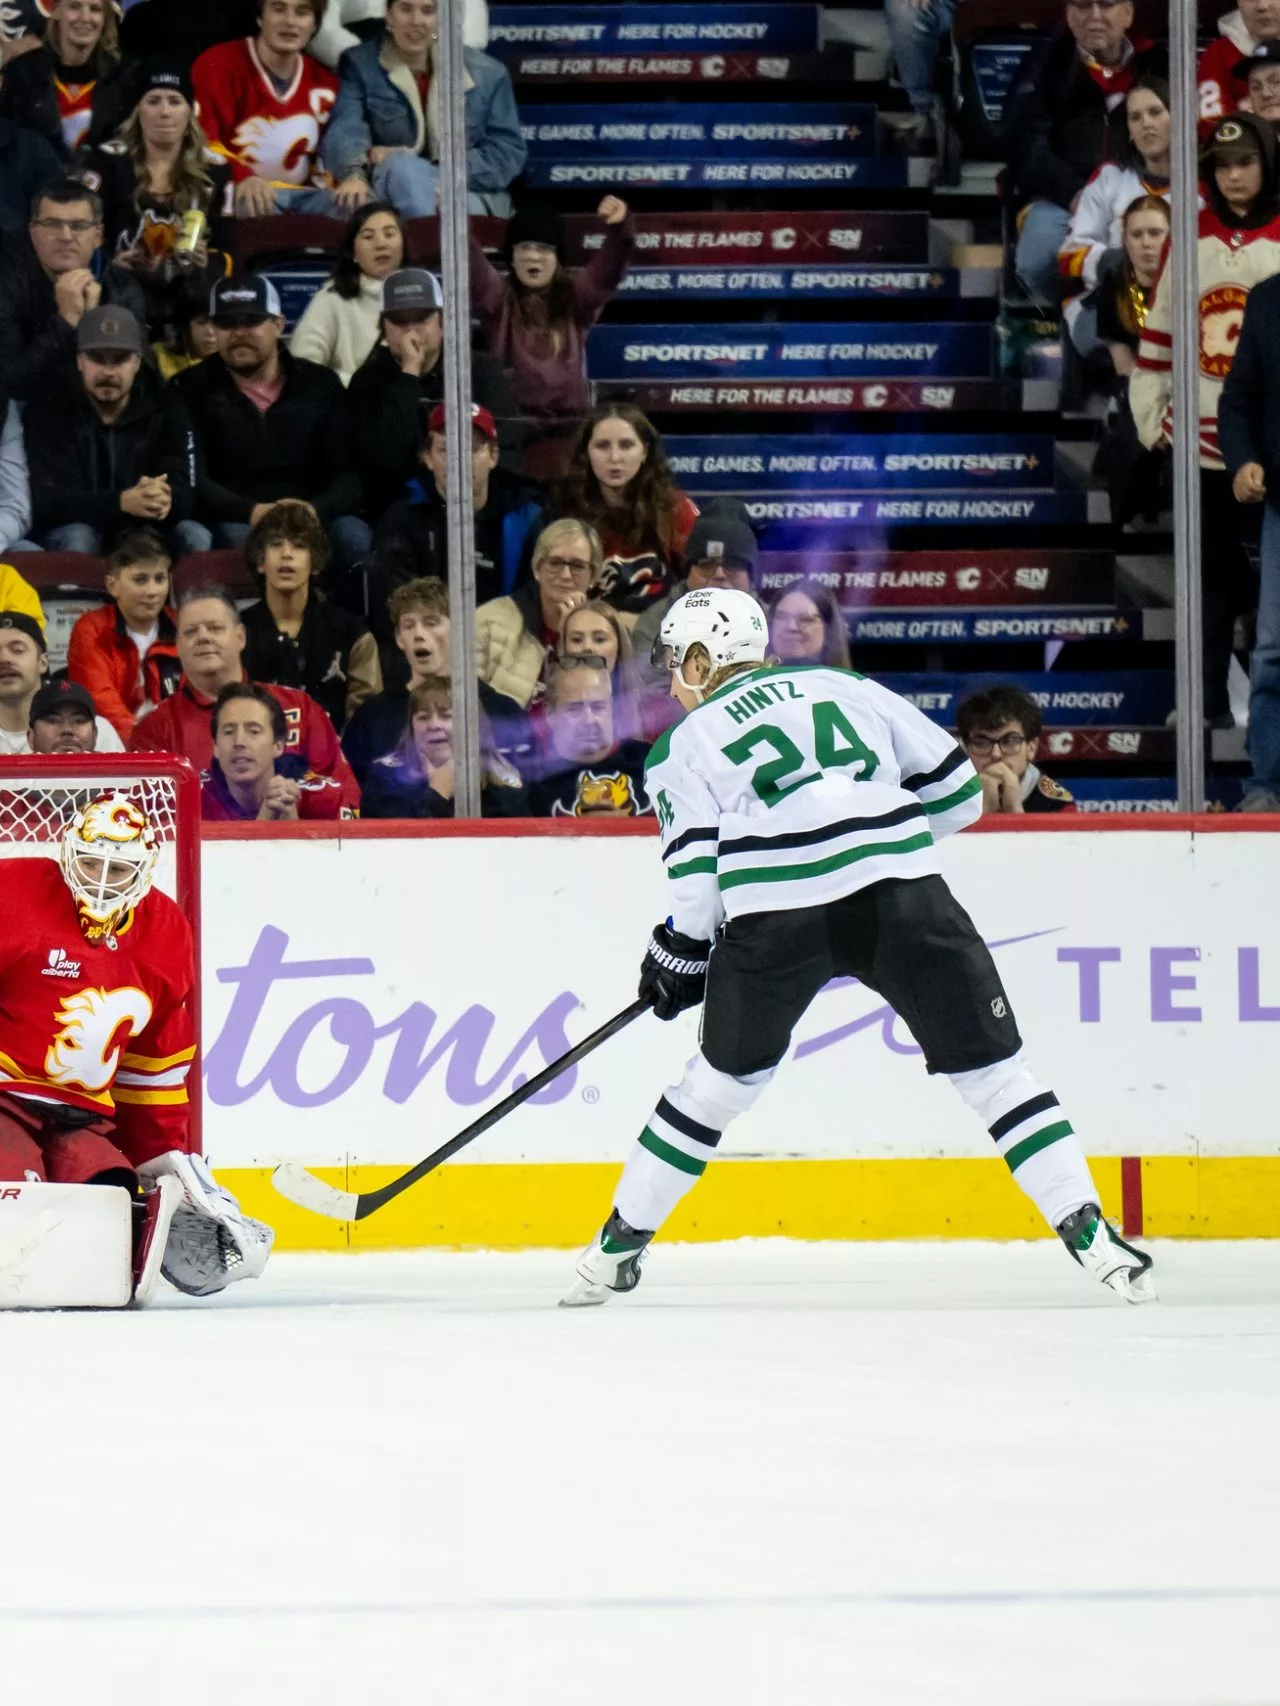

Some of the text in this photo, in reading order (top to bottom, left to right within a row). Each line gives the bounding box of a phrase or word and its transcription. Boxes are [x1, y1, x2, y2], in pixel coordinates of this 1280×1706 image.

[617, 24, 661, 39] HERE
[663, 24, 697, 39] FOR
[699, 23, 769, 39] HOCKEY
[520, 59, 560, 75] HERE
[561, 59, 592, 74] FOR
[595, 59, 626, 74] THE
[628, 58, 693, 74] FLAMES
[519, 125, 536, 140] RE
[538, 124, 597, 141] GAMES.
[599, 124, 646, 140] MORE
[649, 124, 706, 140] OFTEN.
[550, 164, 859, 182] SPORTSNET HERE FOR HOCKEY
[583, 234, 607, 249] HE
[664, 232, 694, 248] THE
[697, 231, 764, 248] FLAMES
[617, 274, 673, 290] AMES.
[677, 273, 724, 289] MORE
[728, 273, 785, 289] OFTEN.
[624, 344, 939, 362] SPORTSNET HERE FOR HOCKEY
[670, 388, 711, 405] HERE
[713, 388, 749, 404] FOR
[752, 388, 785, 404] THE
[787, 387, 854, 404] FLAMES
[668, 457, 701, 473] ORE
[703, 456, 765, 473] GAMES.
[769, 456, 817, 473] MORE
[819, 455, 878, 471] OFTEN.
[744, 501, 1035, 519] ORTSNET HERE FOR HOCKEY
[845, 573, 875, 588] THE
[880, 571, 948, 587] FLAMES
[1015, 568, 1050, 591] SN
[685, 599, 710, 608] Eats
[857, 621, 908, 638] MORE
[909, 621, 967, 638] OFTEN.
[724, 681, 805, 724] HINTZ
[1029, 692, 1124, 708] OR HOCKEY
[1108, 731, 1140, 754] SN
[720, 701, 881, 808] 24
[41, 967, 81, 979] alberta
[56, 960, 81, 973] play
[202, 924, 580, 1107] tons
